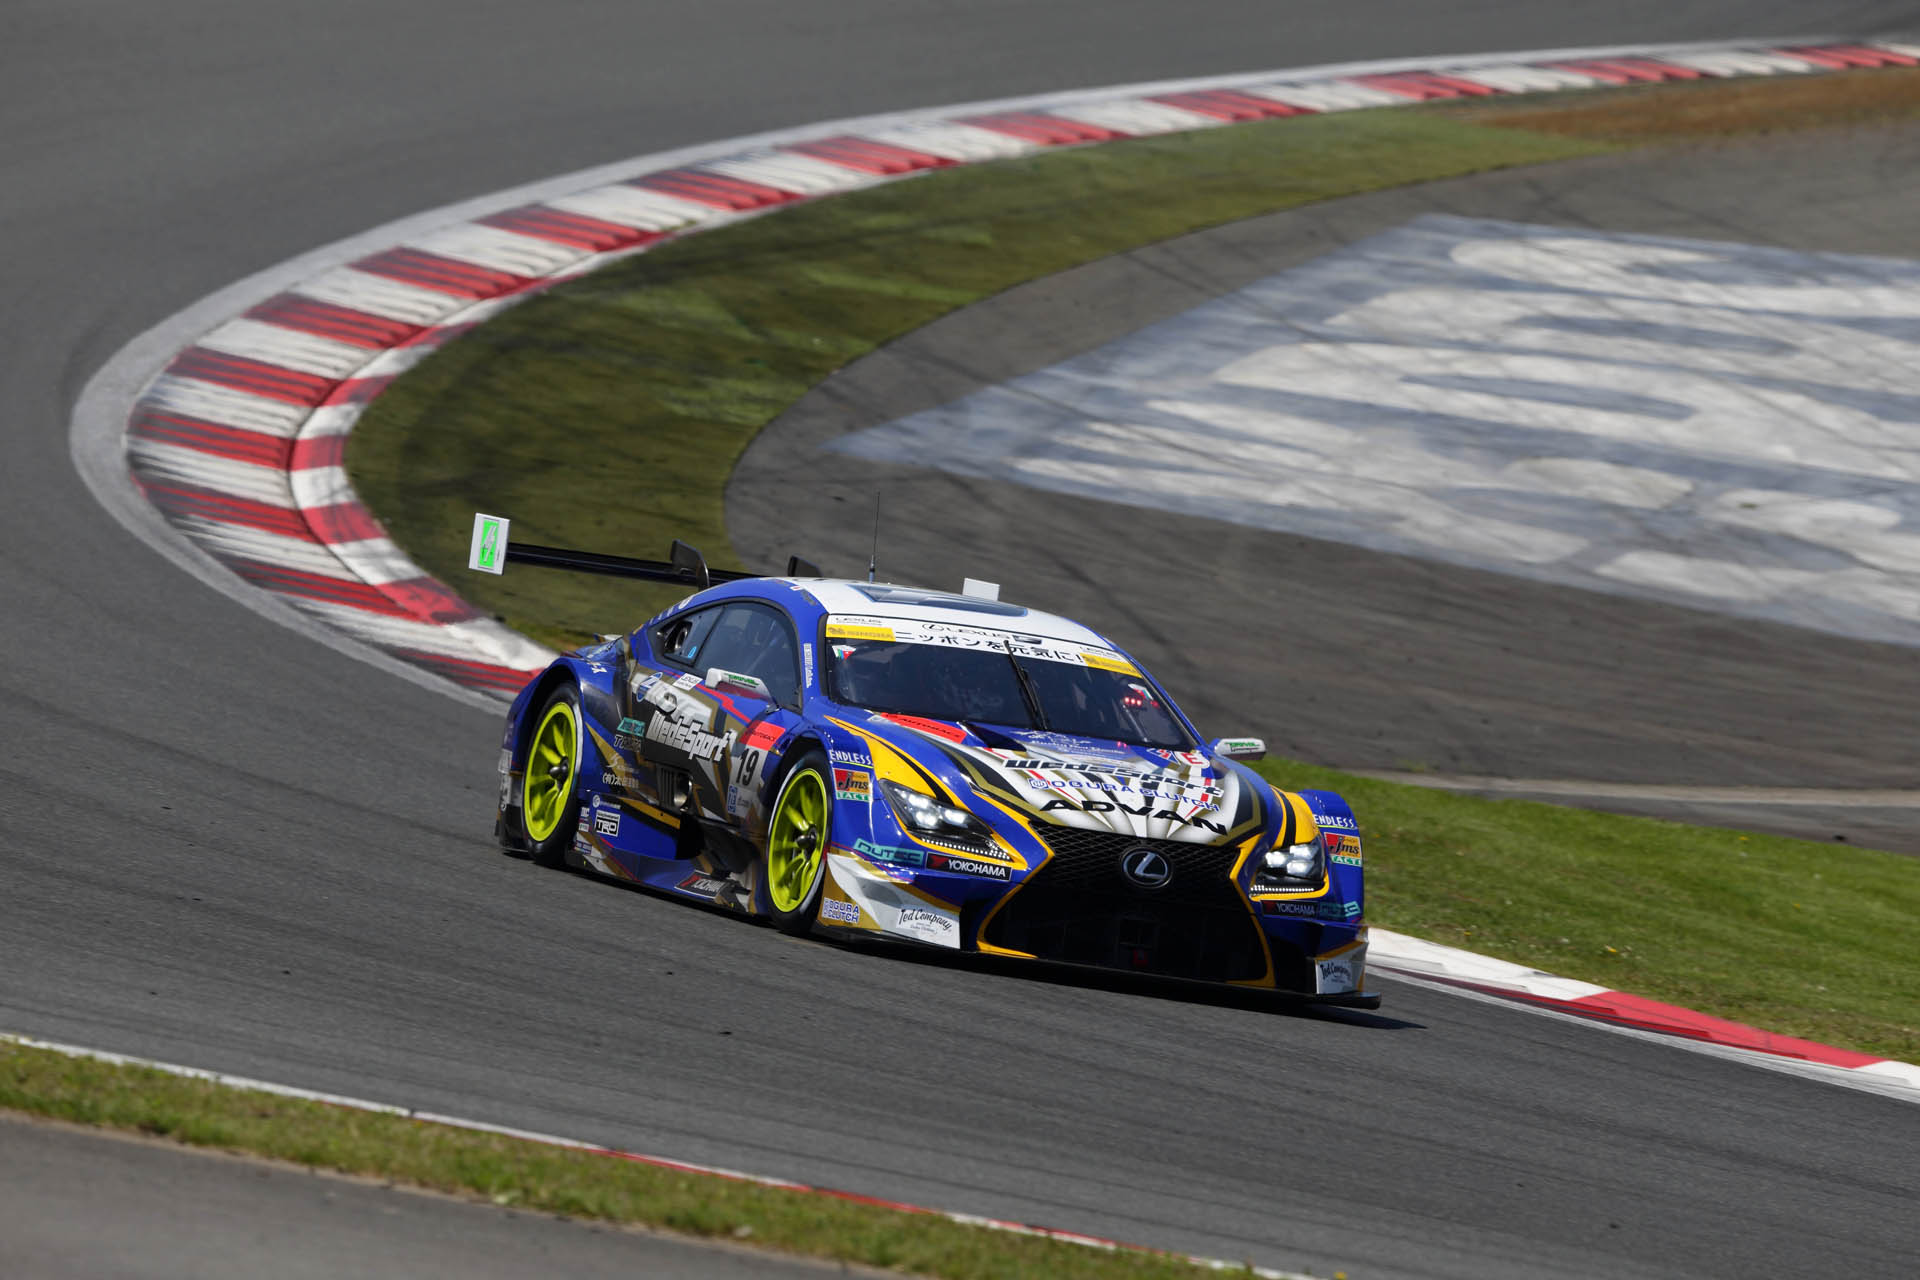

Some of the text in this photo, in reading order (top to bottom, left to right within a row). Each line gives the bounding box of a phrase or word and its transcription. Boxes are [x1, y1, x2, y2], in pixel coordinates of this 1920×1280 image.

[645, 710, 730, 762] WedsSport
[736, 748, 760, 786] 19
[829, 749, 872, 765] ENDLESS
[1051, 780, 1220, 812] OGURA CLUTCH
[1039, 800, 1228, 836] ADVAN
[1313, 813, 1354, 828] ENDLESS
[948, 858, 1006, 878] YOKOHAMA
[828, 910, 859, 923] CLUTCH
[829, 900, 860, 914] OGURA
[1277, 903, 1315, 914] YOKOHAMA
[899, 909, 914, 925] Ted
[915, 909, 953, 931] Company
